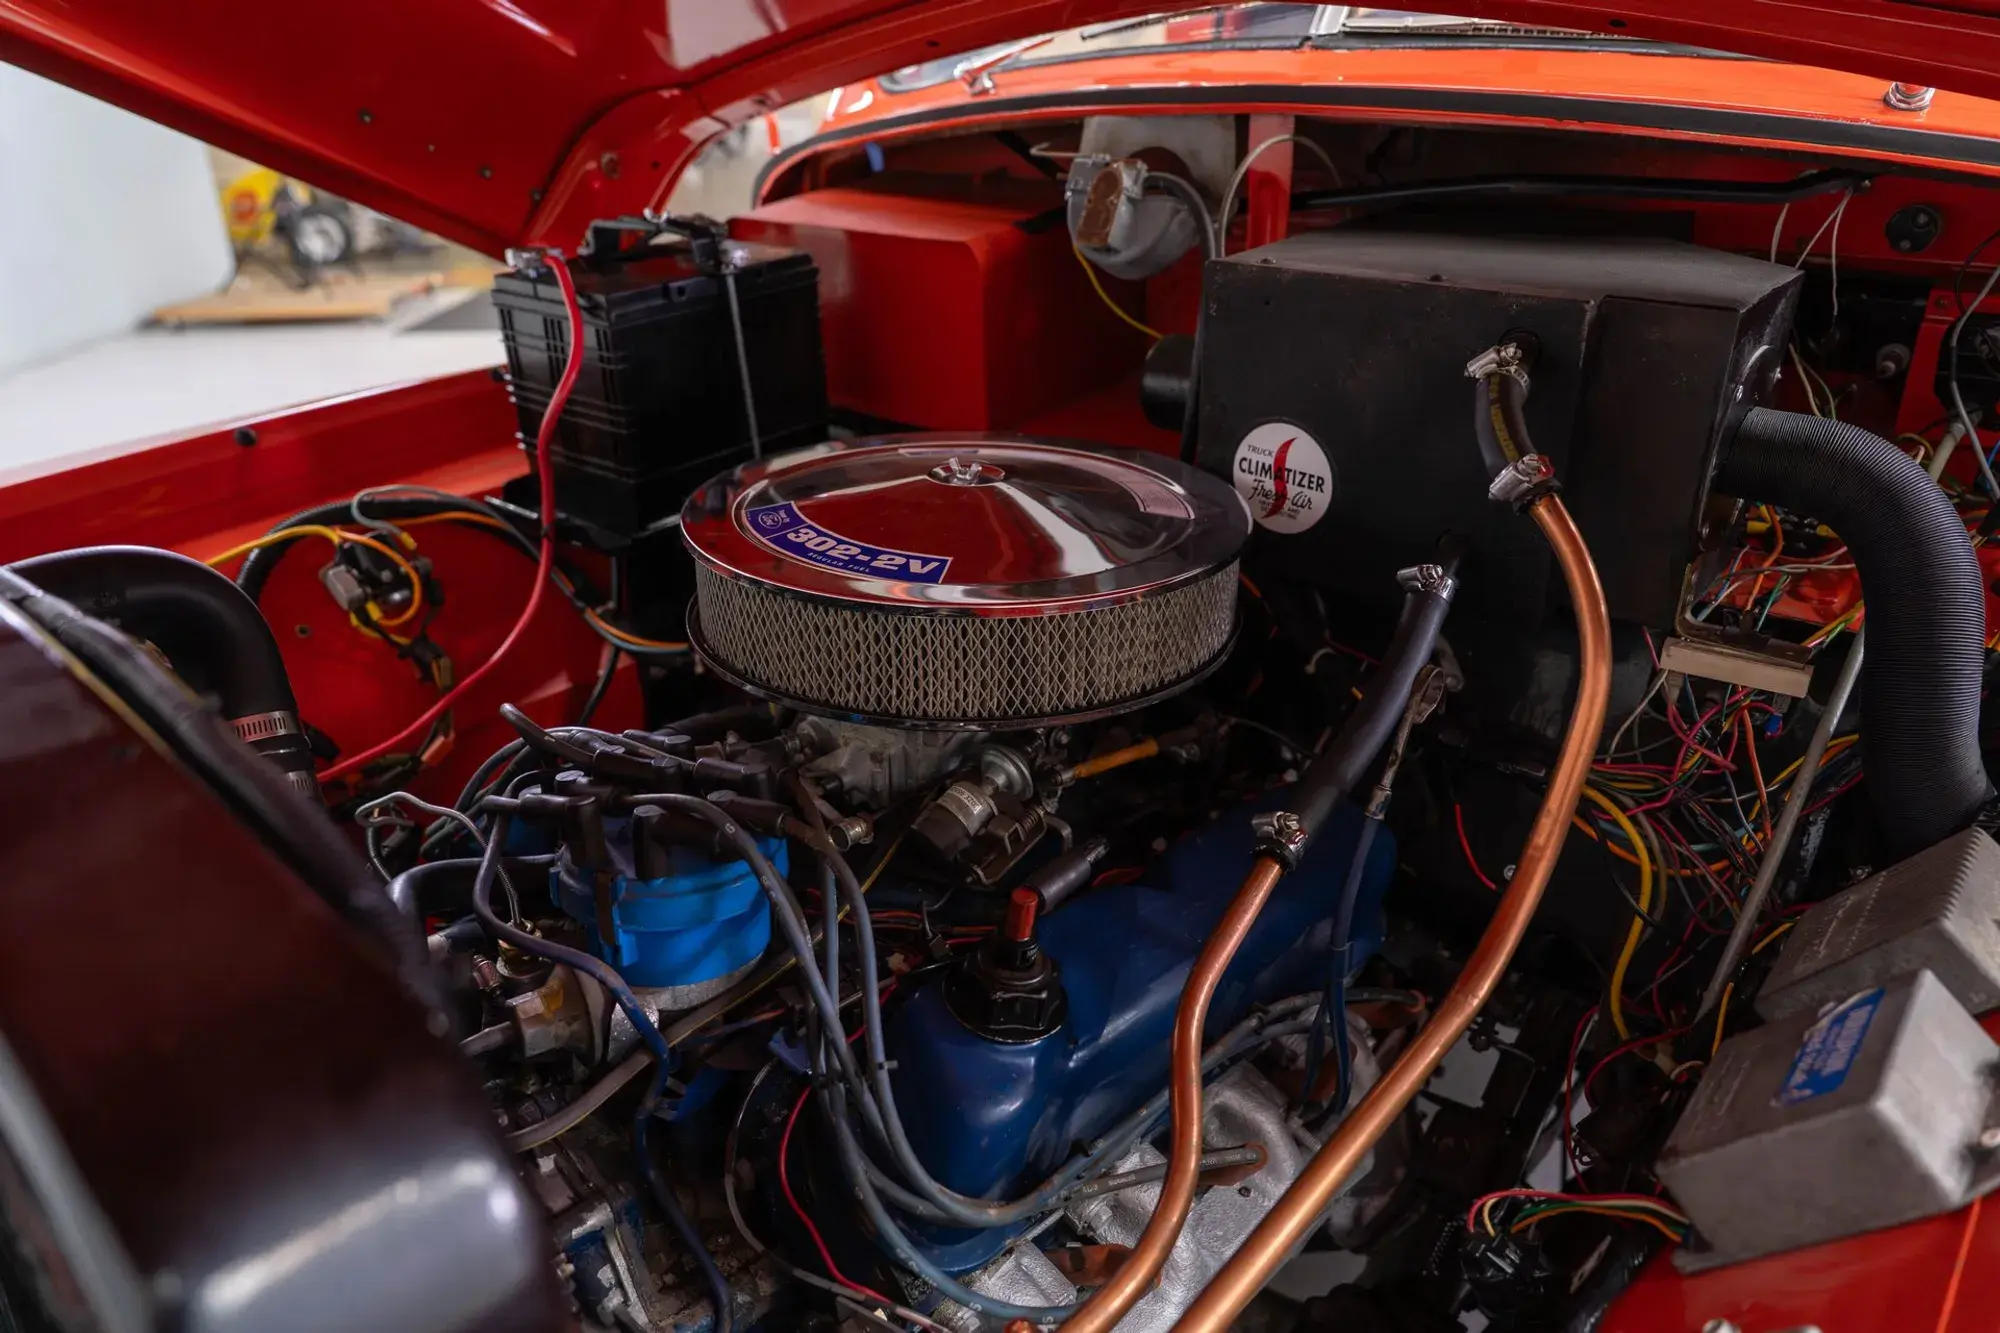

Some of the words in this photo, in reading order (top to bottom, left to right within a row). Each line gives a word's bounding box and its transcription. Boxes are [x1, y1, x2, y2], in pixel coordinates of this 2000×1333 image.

[1247, 444, 1274, 457] TRUCK
[1238, 457, 1325, 494] CLIMATIZER
[1291, 491, 1313, 510] Air
[787, 527, 941, 574] 302-2V
